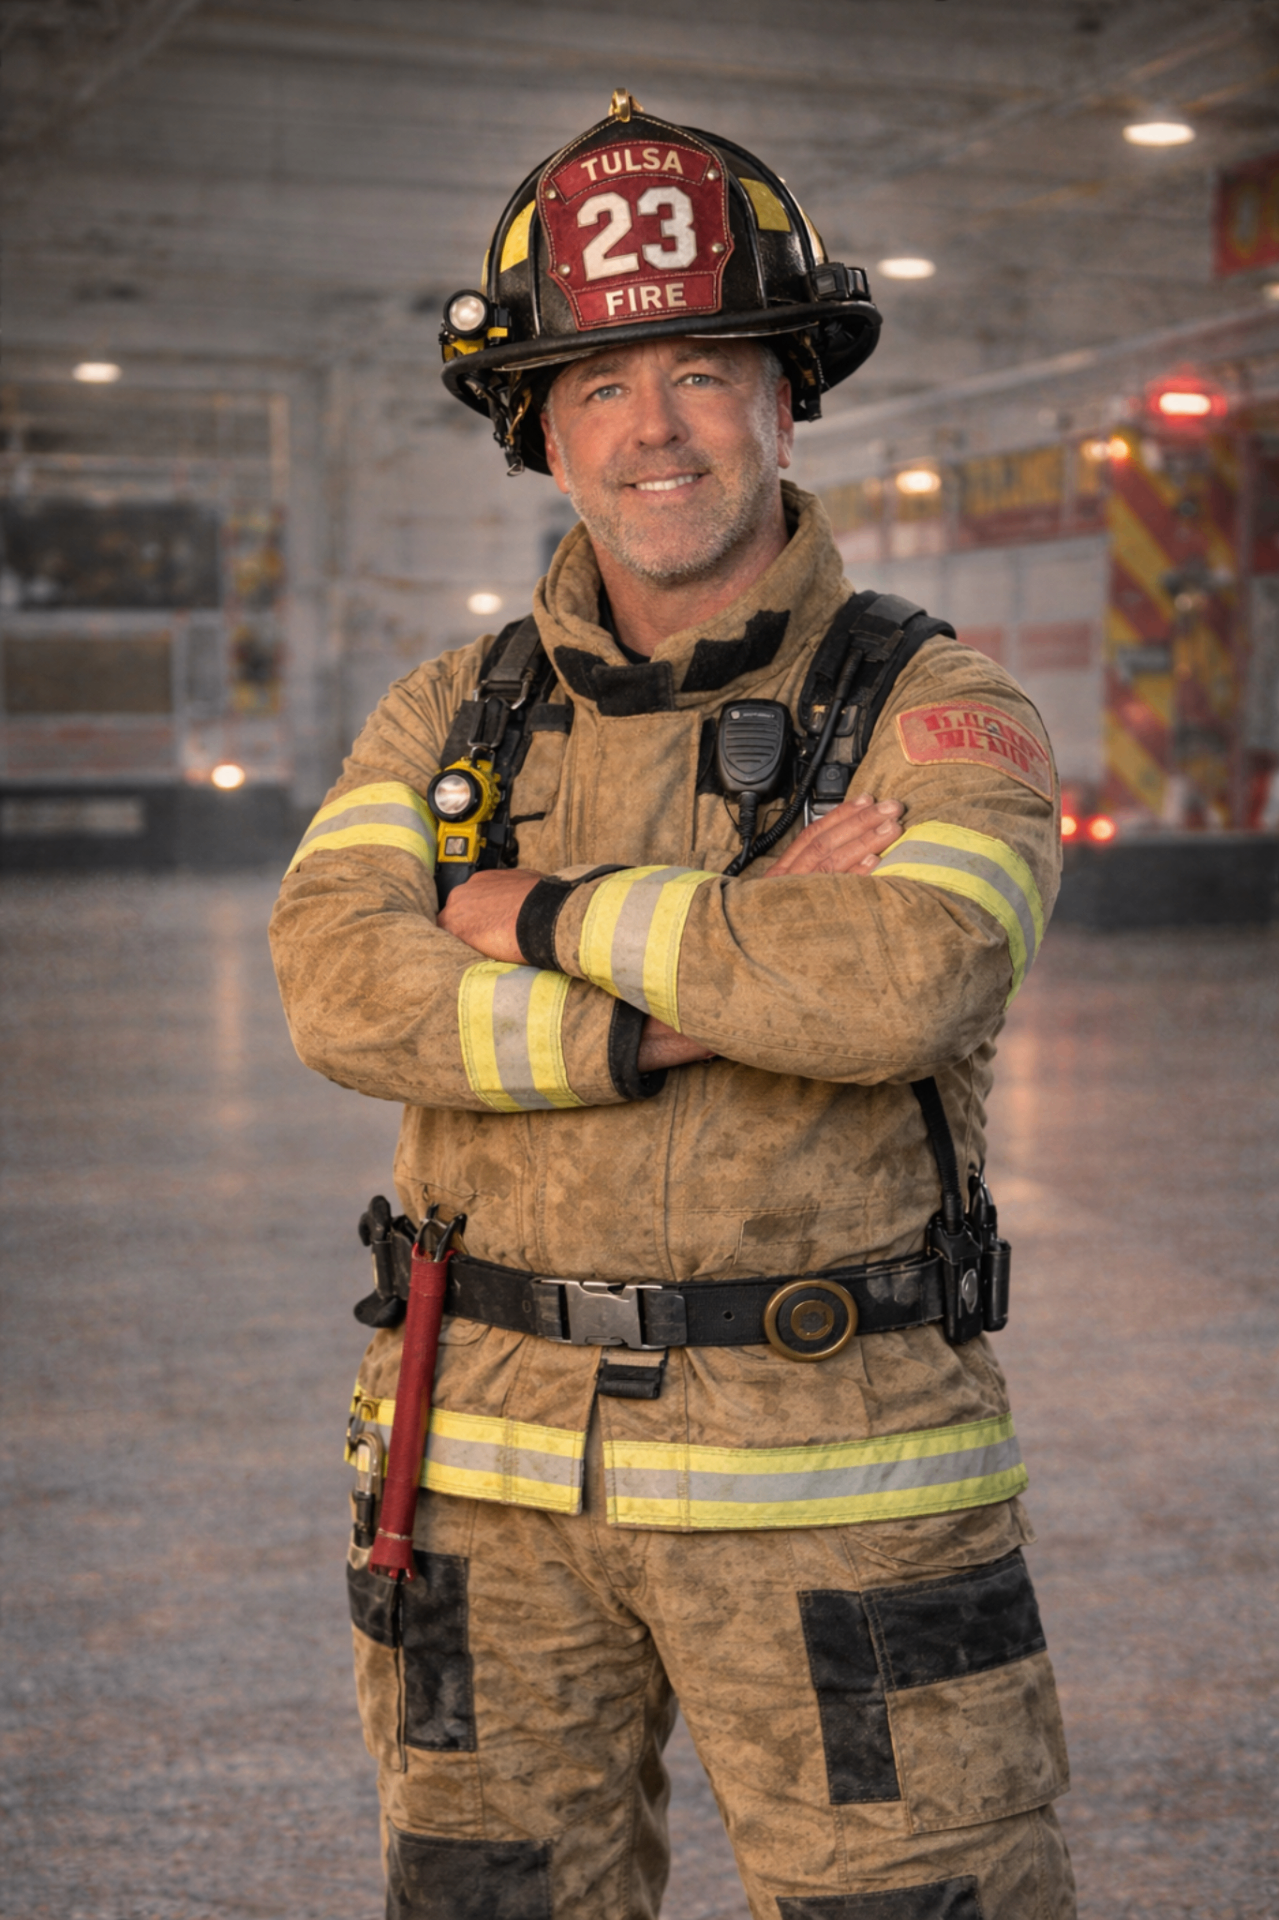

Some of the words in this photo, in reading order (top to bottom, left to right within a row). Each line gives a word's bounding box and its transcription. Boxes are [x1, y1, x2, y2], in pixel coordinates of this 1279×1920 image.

[581, 147, 684, 181] TULSA
[576, 186, 698, 282] 23
[605, 283, 688, 316] FIRE
